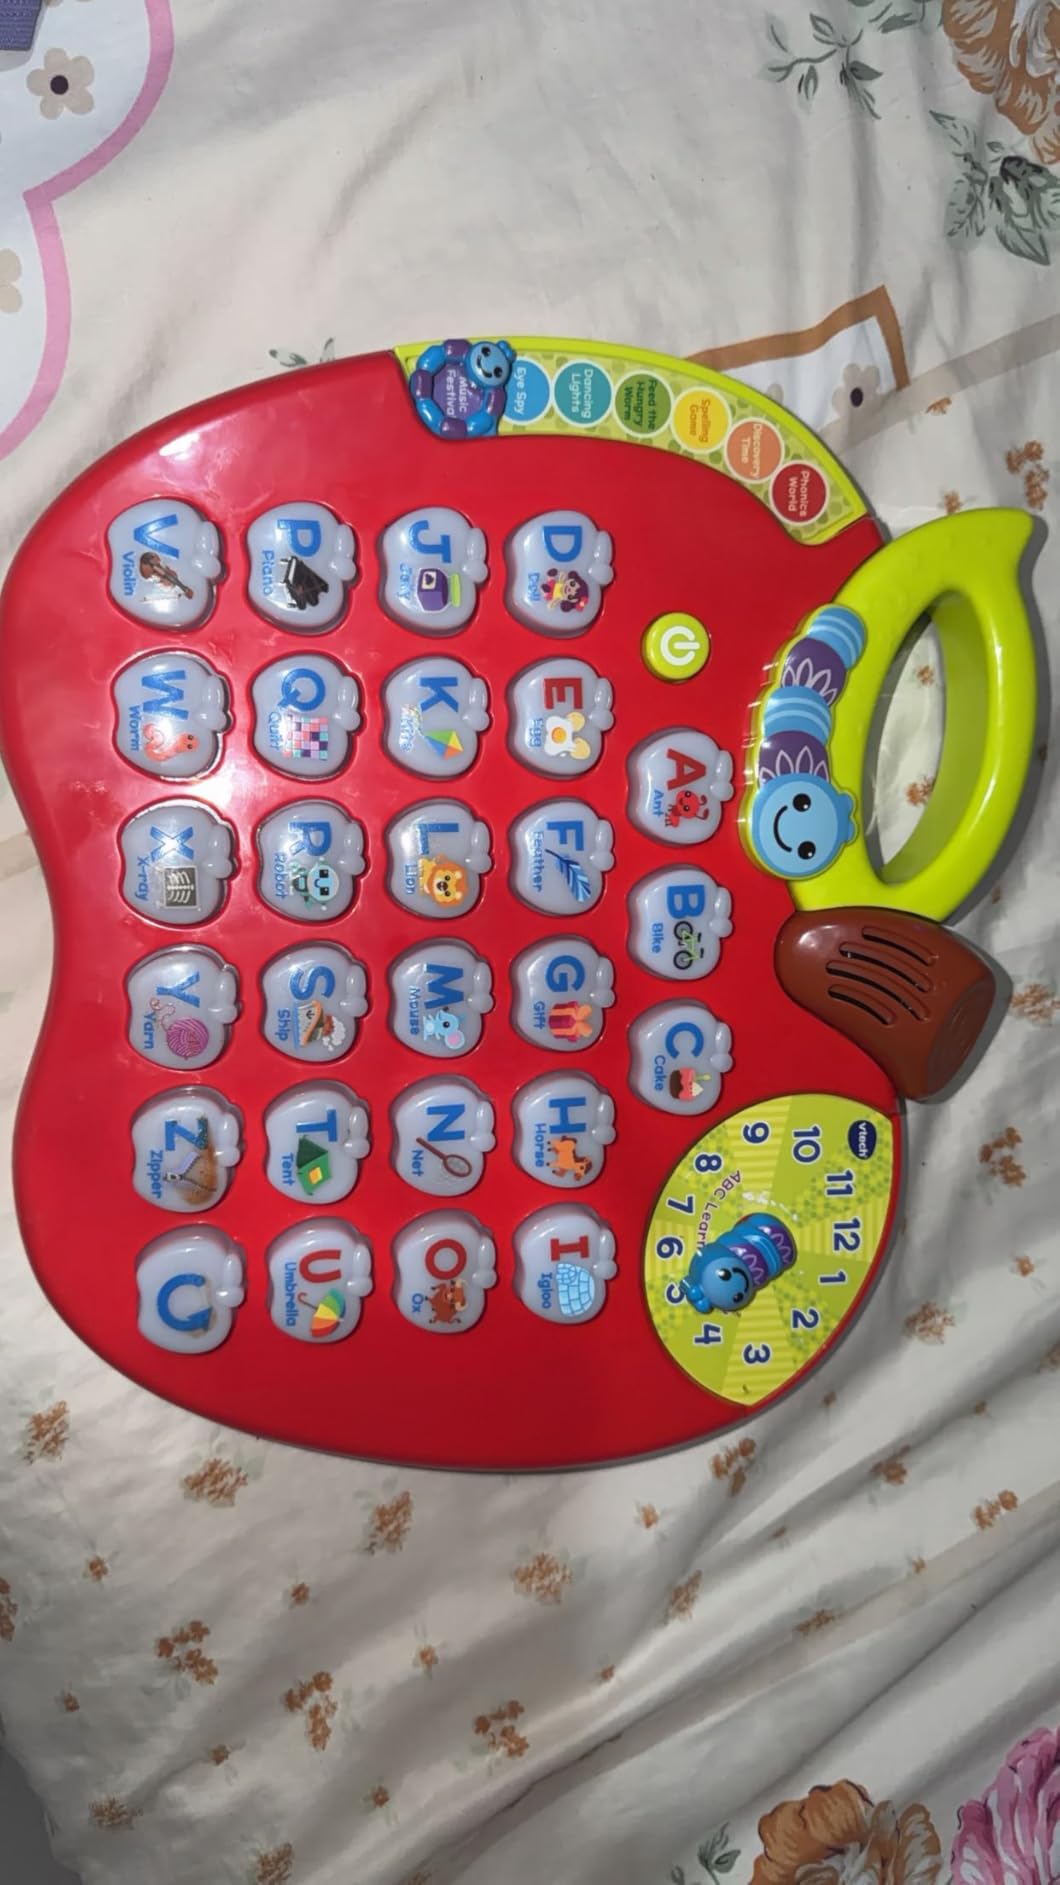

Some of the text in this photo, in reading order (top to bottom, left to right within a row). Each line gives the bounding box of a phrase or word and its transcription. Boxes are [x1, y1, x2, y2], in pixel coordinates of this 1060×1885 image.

[459, 376, 469, 413] Music
[514, 367, 527, 414] Eye Spy
[569, 373, 581, 413] Lights
[581, 368, 593, 418] Dancing
[623, 386, 633, 420] Worm
[633, 381, 646, 426] Hungry
[647, 379, 657, 430] Feed the
[688, 404, 699, 436] Game
[699, 399, 711, 443] Spelling
[741, 437, 751, 463] Time
[751, 423, 762, 478] Discovery
[788, 476, 798, 512] World
[799, 470, 809, 517] Phonics
[133, 514, 180, 559] V
[277, 519, 322, 557] P
[409, 520, 451, 564] J
[543, 525, 583, 563] D
[121, 551, 135, 596] Violin
[261, 550, 275, 596] Piano
[142, 670, 189, 720] W
[277, 668, 326, 711] Q
[419, 676, 459, 712] K
[543, 677, 583, 710] E
[128, 705, 141, 752] Worm
[268, 711, 282, 751] Quilt
[667, 748, 706, 790] A
[652, 789, 665, 817] Ant
[150, 826, 194, 862] X
[288, 821, 331, 856] R
[420, 823, 459, 855] L
[546, 820, 584, 851] F
[135, 856, 149, 900] X-ray
[274, 853, 287, 899] Robot
[405, 864, 417, 895] Lion
[533, 831, 545, 892] Feather
[666, 884, 705, 919] B
[651, 923, 663, 954] Bike
[156, 971, 200, 1008] Y
[289, 966, 335, 1000] S
[425, 964, 464, 1009] M
[545, 955, 585, 992] G
[275, 1009, 290, 1041] Ship
[408, 987, 421, 1036] Mouse
[533, 1001, 546, 1029] Gift
[143, 1012, 155, 1049] Yarn
[665, 1022, 705, 1058] C
[653, 1055, 667, 1091] Cake
[296, 1109, 337, 1142] T
[426, 1104, 465, 1142] N
[549, 1097, 586, 1134] H
[743, 1122, 769, 1144] 9
[165, 1119, 208, 1151] Z
[535, 1123, 546, 1168] Horse
[793, 1125, 820, 1163] 10
[148, 1151, 163, 1198] Zipper
[281, 1152, 294, 1186] Tent
[412, 1150, 424, 1176] Net
[695, 1153, 722, 1173] 8
[713, 1170, 742, 1200] ABC
[826, 1170, 854, 1197] 11
[668, 1196, 693, 1214] 7
[550, 1236, 589, 1262] I
[656, 1237, 682, 1259] 6
[833, 1218, 860, 1251] 12
[299, 1250, 341, 1283] U
[425, 1239, 467, 1280] O
[820, 1271, 846, 1284] 1
[284, 1262, 298, 1327] Umbrella
[412, 1293, 424, 1313] Ox
[538, 1272, 553, 1309] Igloo
[695, 1324, 721, 1344] 4
[792, 1309, 819, 1329] 2
[744, 1344, 770, 1365] 3
